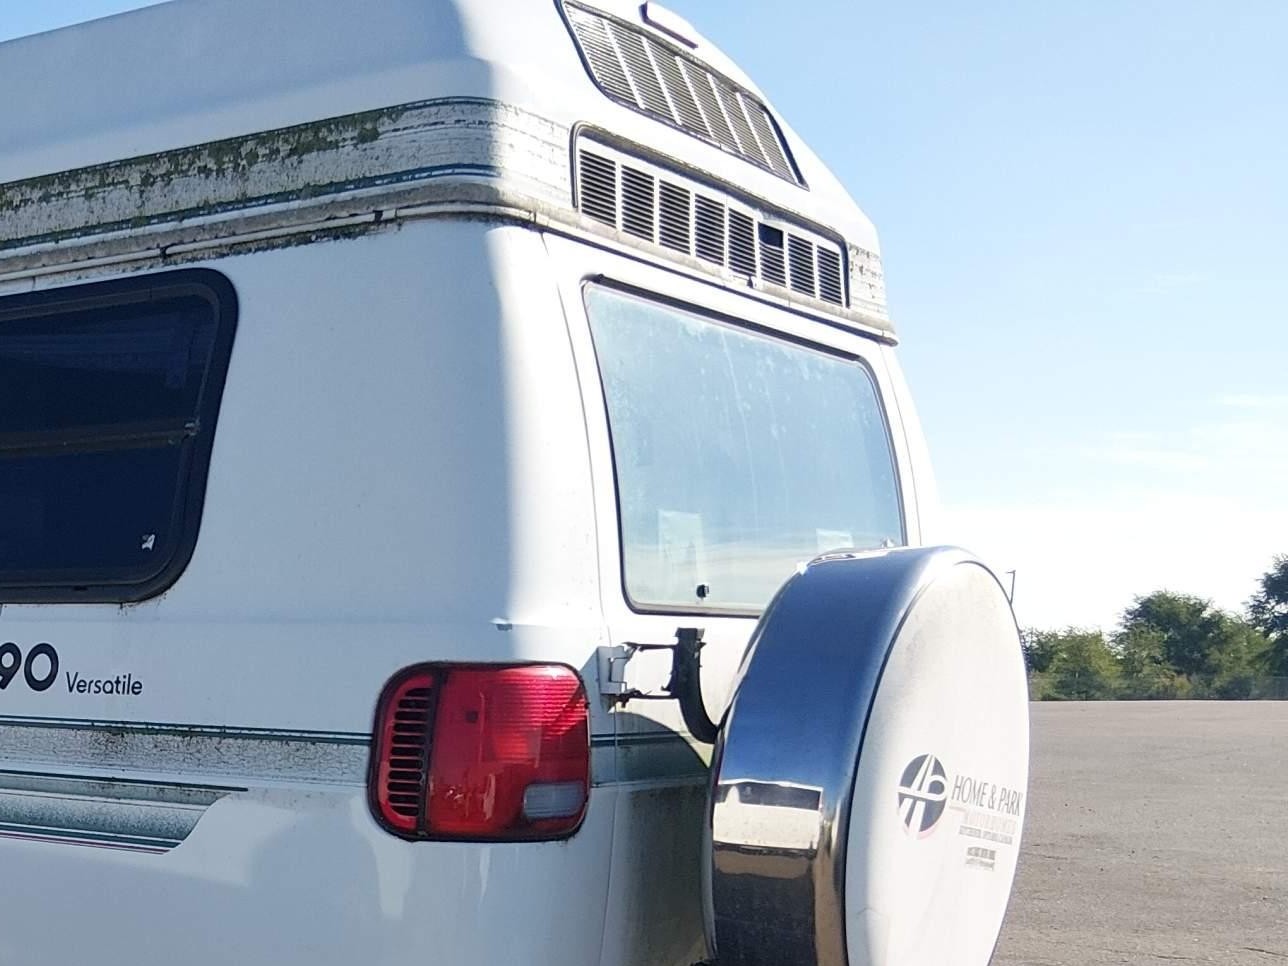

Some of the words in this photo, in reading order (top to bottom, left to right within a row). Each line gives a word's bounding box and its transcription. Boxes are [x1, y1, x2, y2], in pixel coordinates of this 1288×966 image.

[65, 672, 143, 696] Versatile
[952, 775, 987, 807] HOME
[988, 784, 997, 810] &
[998, 788, 1022, 816] PARK
